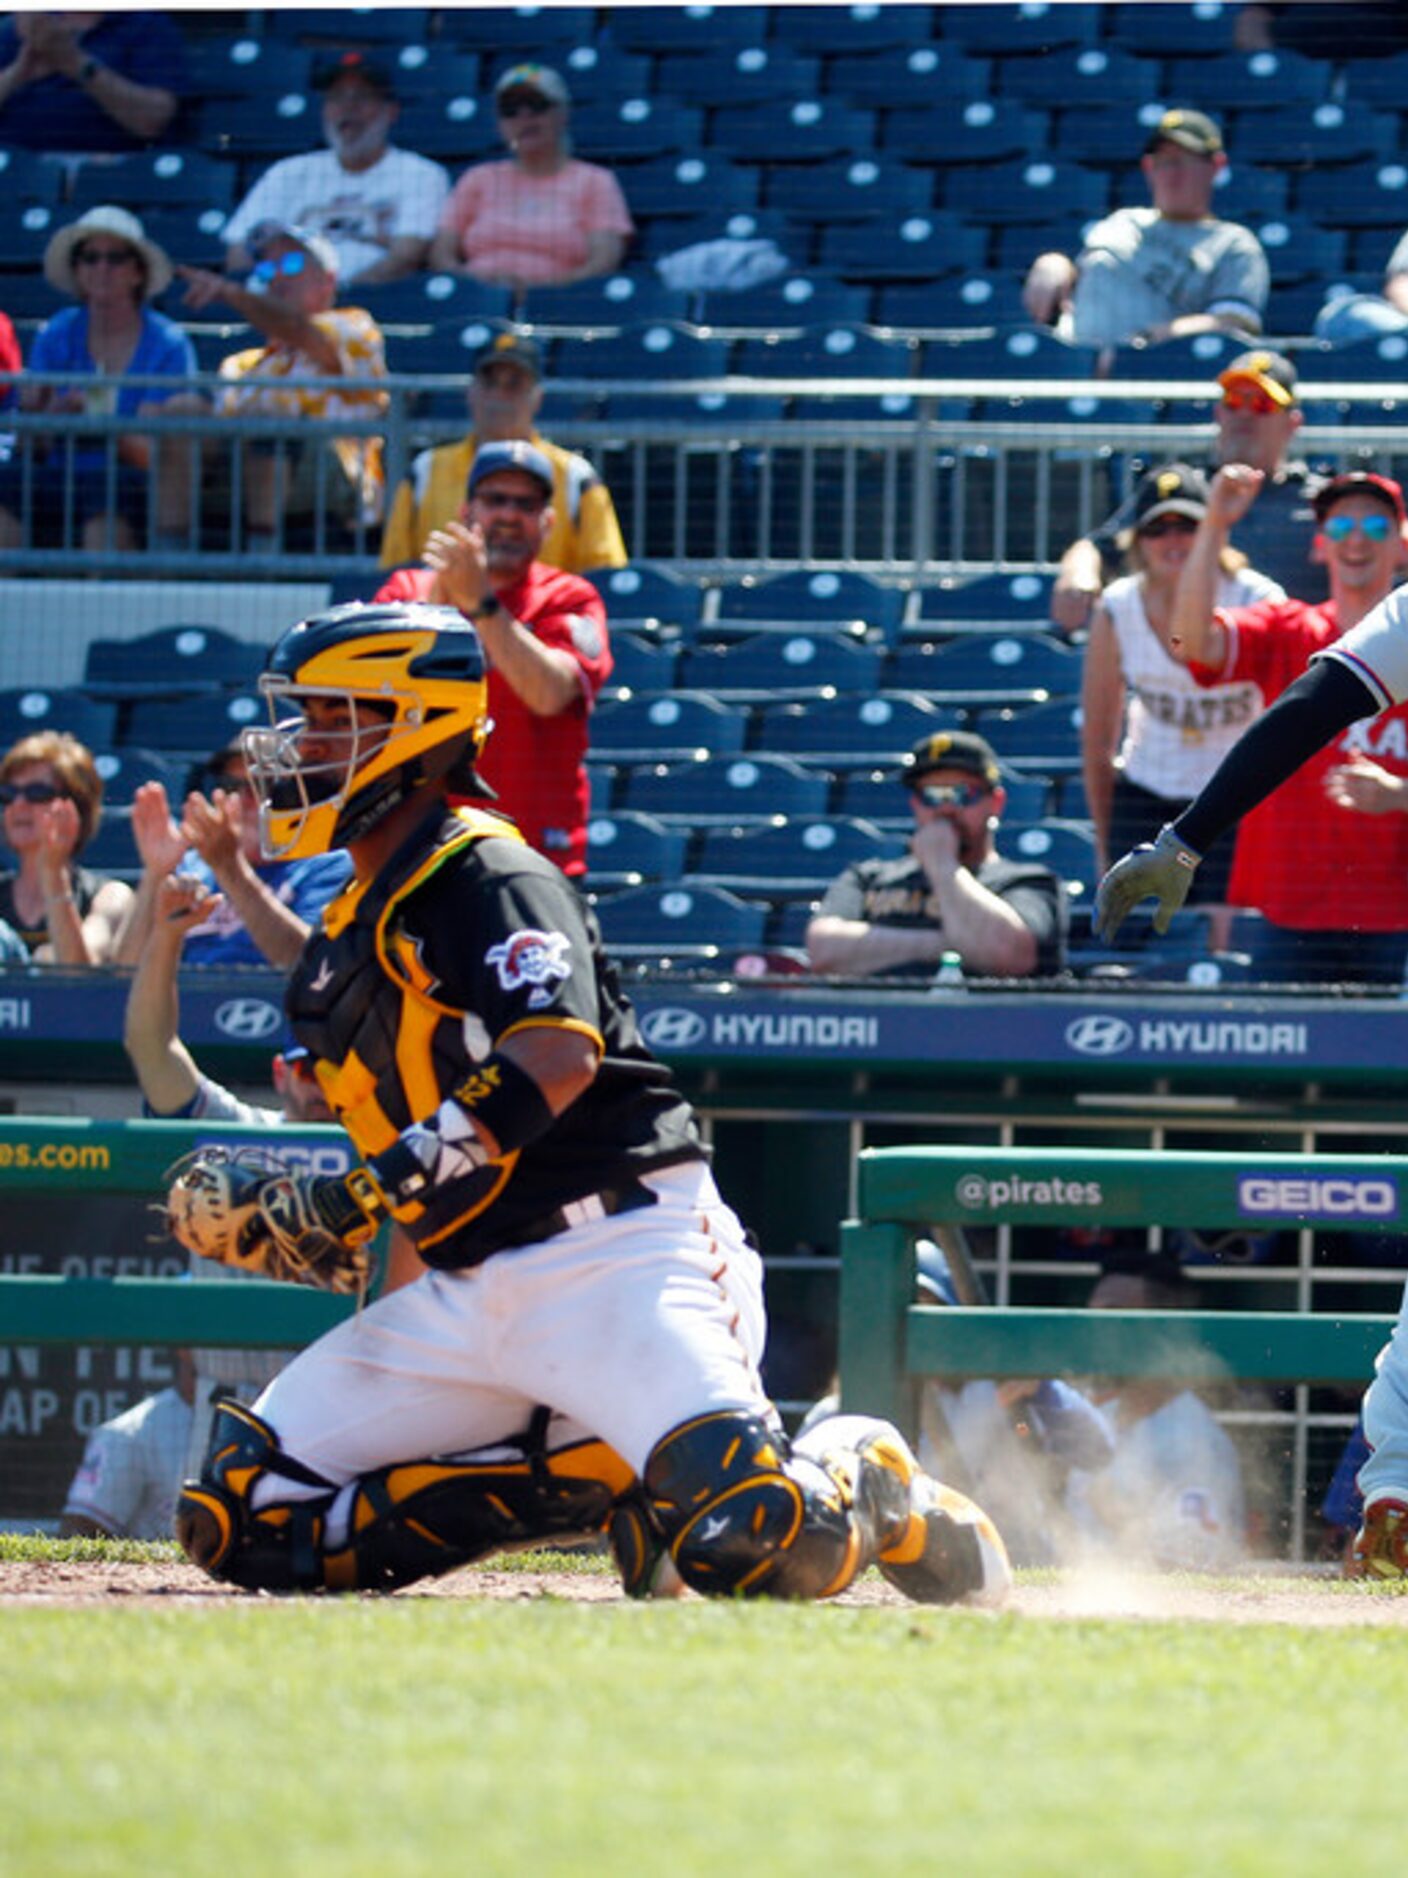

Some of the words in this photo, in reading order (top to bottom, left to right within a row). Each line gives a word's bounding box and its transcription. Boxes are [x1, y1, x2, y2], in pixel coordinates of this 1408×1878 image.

[713, 1014, 878, 1046] HYUNDAI
[1140, 1021, 1308, 1055] HYUNDAI
[955, 1174, 1102, 1208] @pirates
[1240, 1179, 1395, 1214] GEICO
